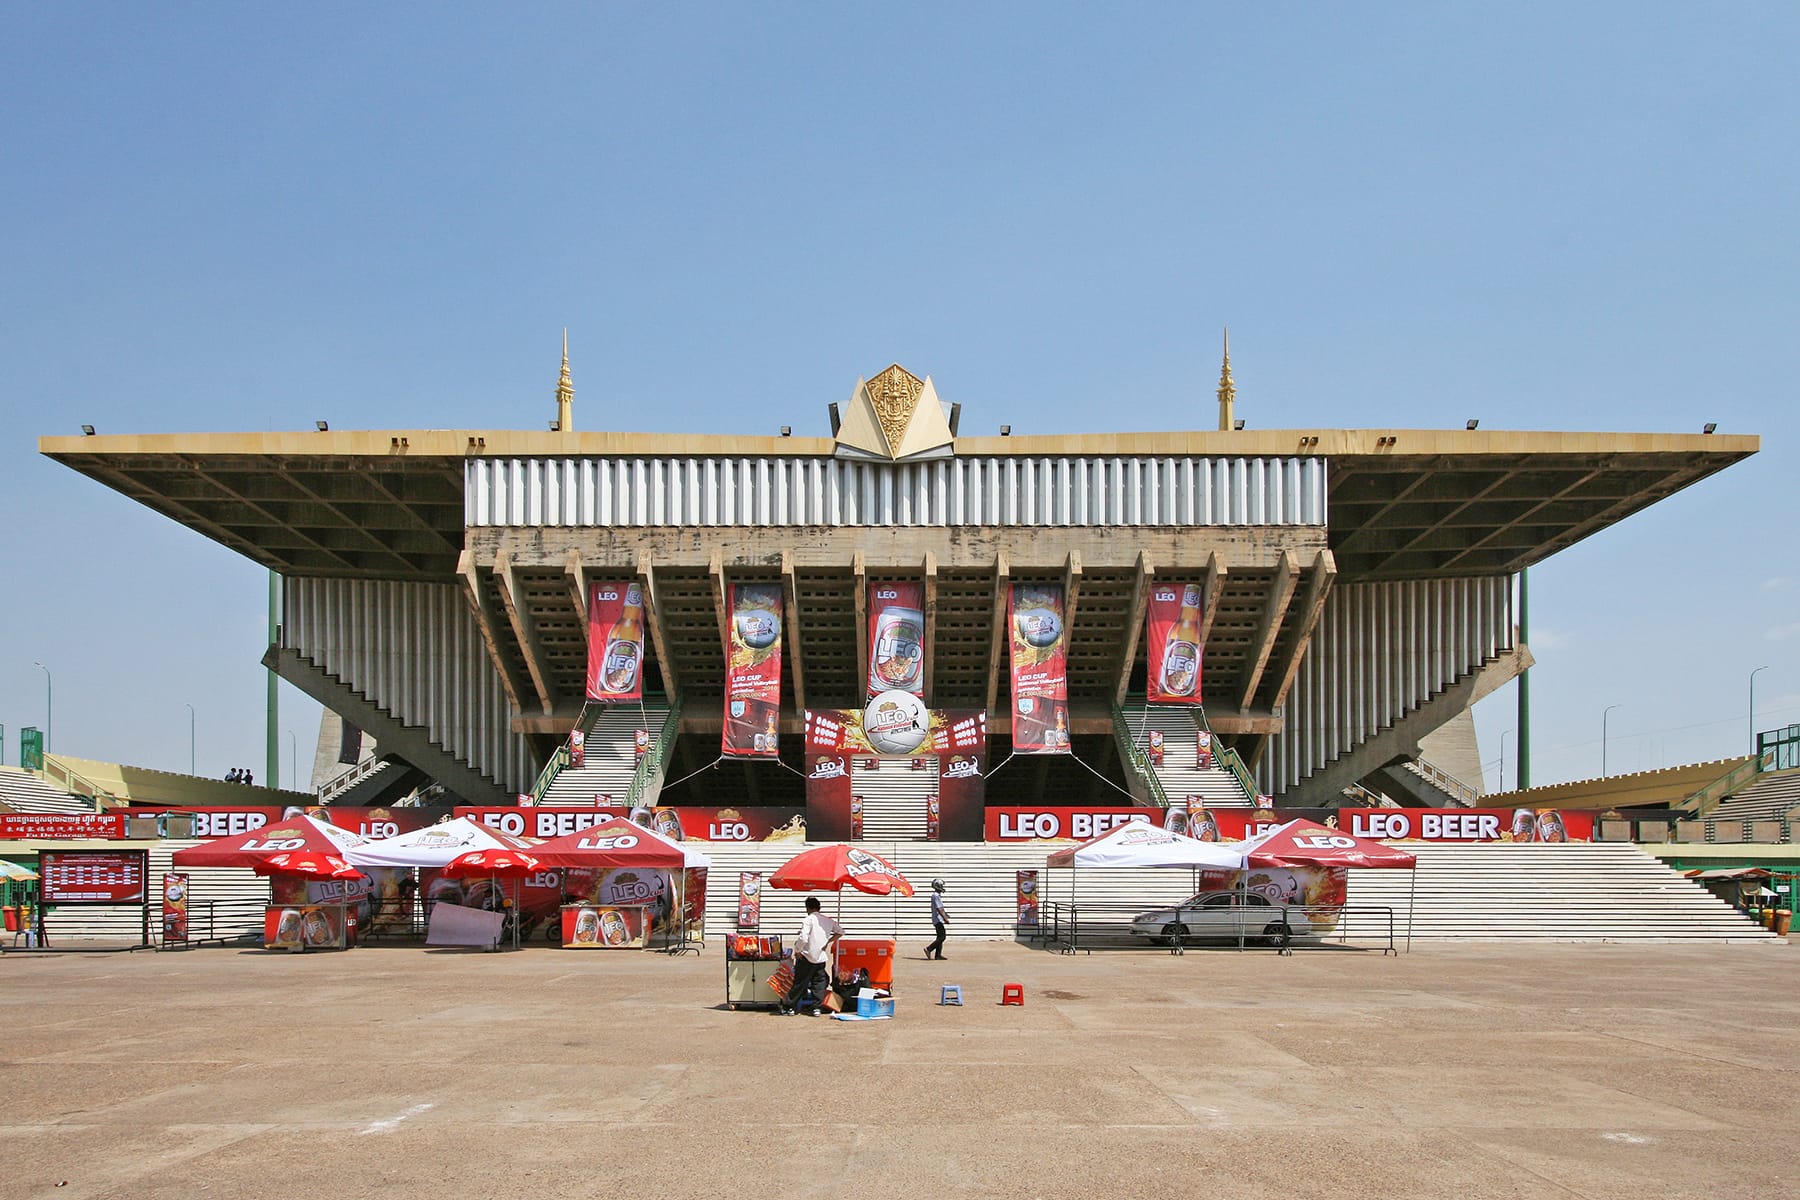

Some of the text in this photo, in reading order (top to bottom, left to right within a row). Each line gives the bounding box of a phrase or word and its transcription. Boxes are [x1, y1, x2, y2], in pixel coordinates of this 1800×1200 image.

[598, 592, 618, 601] LEO
[877, 591, 897, 599] LEO
[1155, 593, 1176, 601] LEO
[878, 638, 922, 664] LEO
[608, 655, 636, 674] LEO
[1168, 656, 1195, 676] LEO
[1032, 672, 1048, 680] CUP
[876, 710, 907, 727] LEO
[815, 762, 836, 773] LEO
[948, 761, 970, 772] LEO
[360, 822, 399, 838] LEO
[709, 823, 750, 841] LEO
[1000, 813, 1060, 838] LEO
[1194, 821, 1215, 838] LEO
[1352, 814, 1500, 839] LEO BEER
[239, 838, 306, 851] LEO
[577, 835, 639, 850] LEO
[1291, 836, 1357, 849] LEO
[525, 872, 559, 888] LEO
[320, 880, 361, 900] LEO
[610, 882, 650, 902] LEO
[604, 921, 625, 938] LEO
